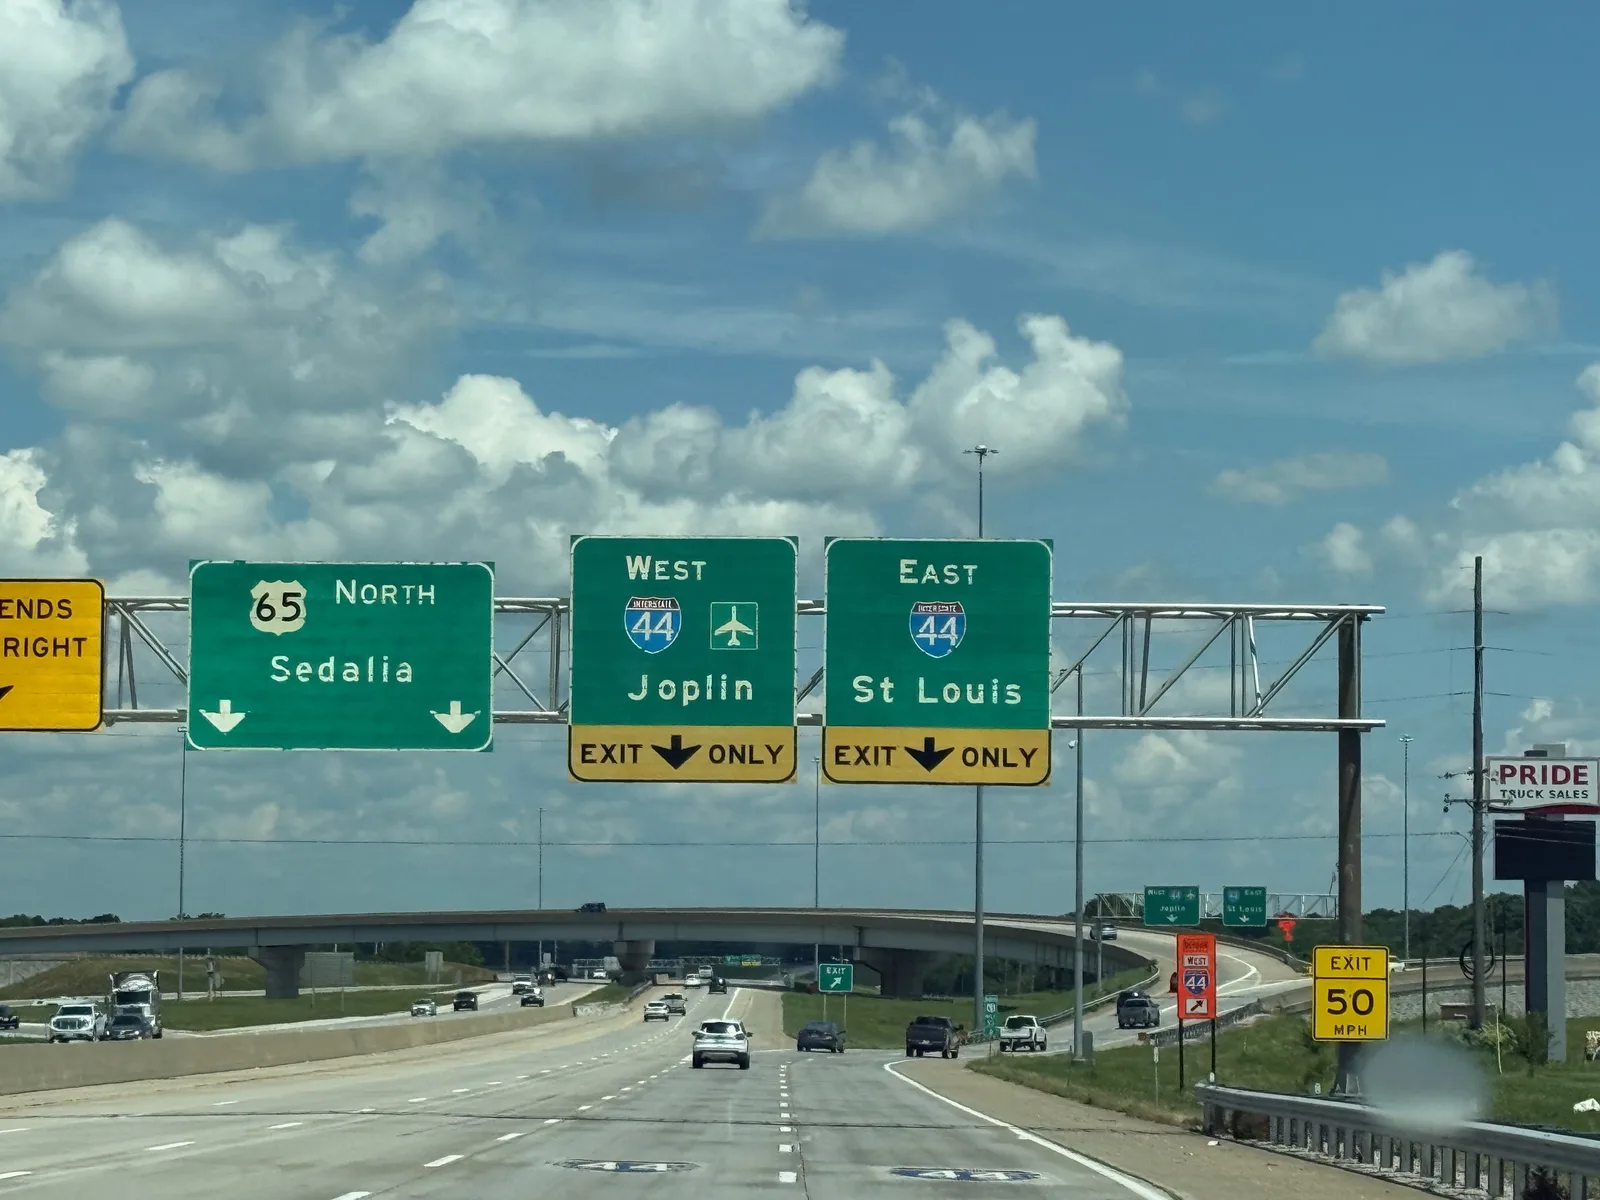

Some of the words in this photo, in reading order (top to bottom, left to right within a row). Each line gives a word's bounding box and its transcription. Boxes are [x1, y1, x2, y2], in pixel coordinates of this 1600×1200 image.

[626, 555, 707, 581] WEST
[900, 559, 979, 585] EAST
[335, 579, 436, 606] NORTH
[0, 598, 73, 620] ENDS
[255, 592, 303, 622] 65
[631, 612, 675, 641] 44
[916, 615, 959, 646] 44
[3, 637, 88, 658] RIGHT
[271, 655, 413, 683] Sedalia
[627, 673, 753, 706] Joplin
[853, 675, 894, 703] St
[919, 677, 1022, 705] Louis
[581, 744, 643, 765] EXIT
[709, 744, 784, 765] ONLY
[835, 746, 897, 767] EXIT
[962, 746, 1038, 768] ONLY
[1500, 764, 1589, 786] PRIDE
[1500, 789, 1544, 799] TRUCK
[1549, 789, 1589, 799] SALES
[826, 967, 846, 975] EXIT
[1187, 956, 1207, 966] WEST
[1330, 956, 1372, 972] EXIT
[1185, 976, 1207, 990] 44
[1327, 988, 1375, 1016] 50
[1334, 1024, 1368, 1036] MPH
